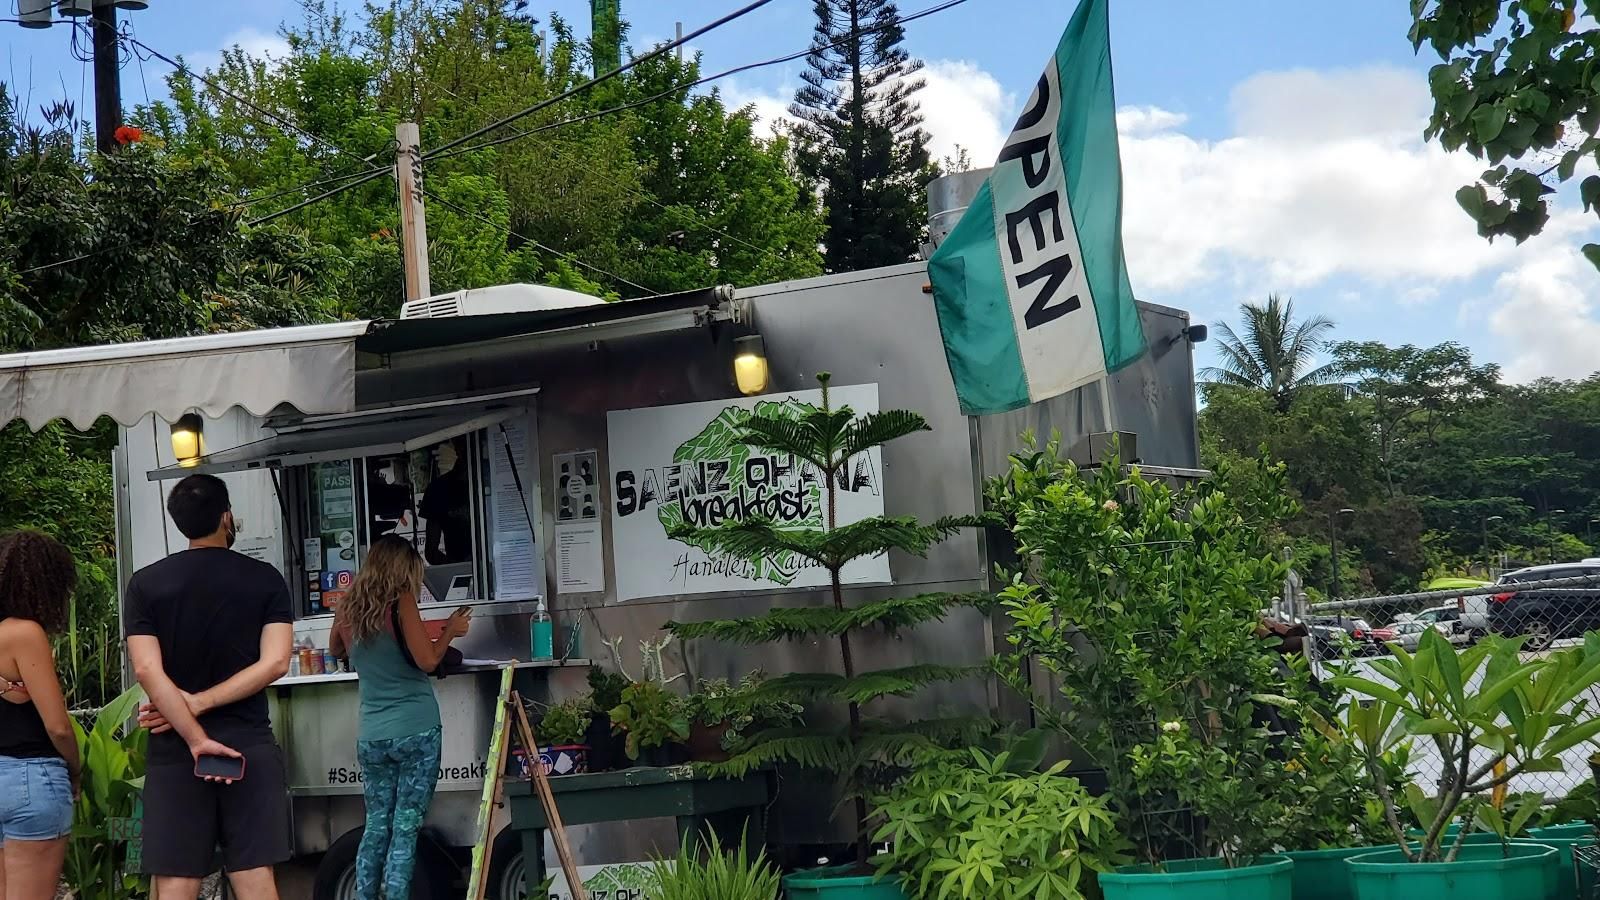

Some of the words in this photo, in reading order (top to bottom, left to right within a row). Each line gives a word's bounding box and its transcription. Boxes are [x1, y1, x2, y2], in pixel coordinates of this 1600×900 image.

[324, 475, 351, 488] PASS
[615, 459, 730, 517] SAENZ
[679, 478, 812, 527] breakfast
